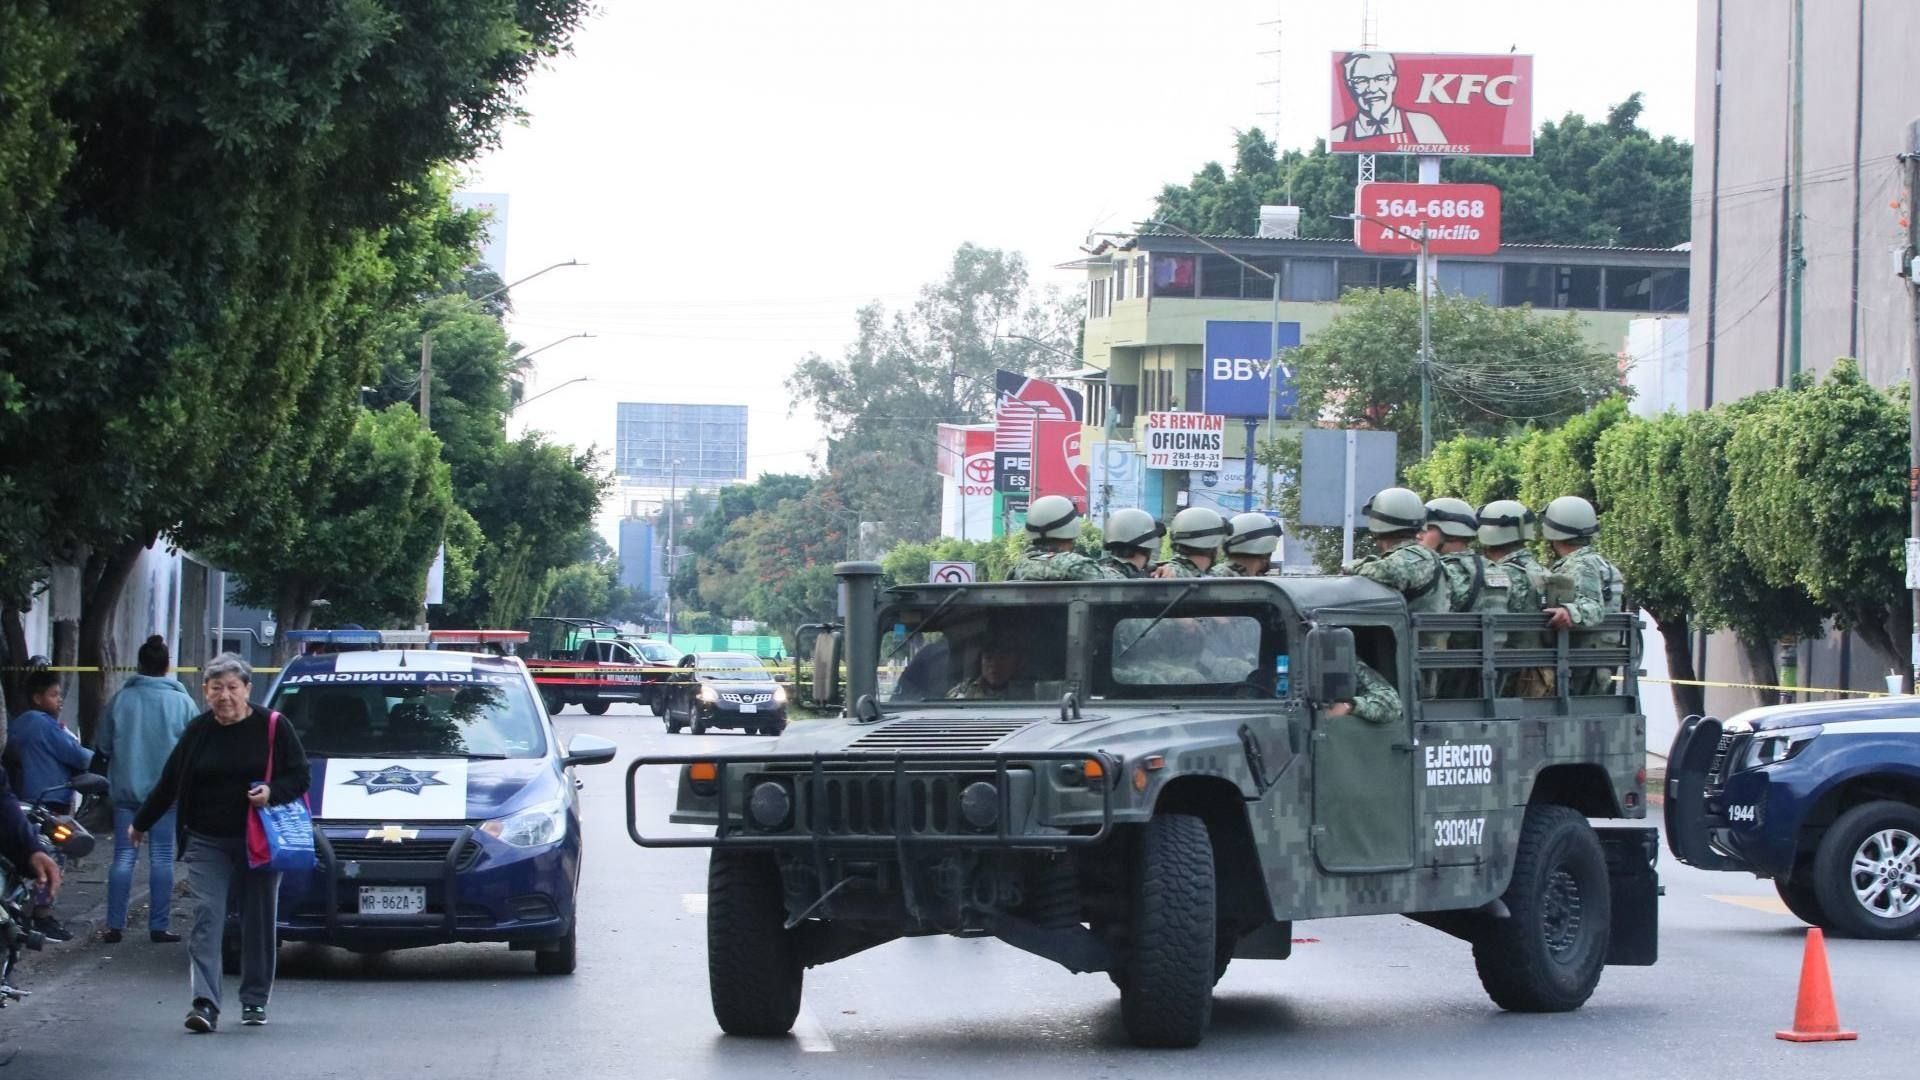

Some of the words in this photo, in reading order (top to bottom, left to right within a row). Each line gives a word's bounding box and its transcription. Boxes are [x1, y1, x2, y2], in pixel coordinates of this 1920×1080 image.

[1415, 73, 1519, 106] KFC
[1396, 144, 1471, 154] AUTOEXPRESS
[1376, 199, 1485, 218] 364-6868
[1380, 226, 1394, 240] A
[1398, 225, 1480, 240] Domicilio
[1150, 413, 1167, 428] SE
[1170, 414, 1222, 430] RENTAN
[1152, 432, 1220, 450] OFICINAS
[1152, 453, 1169, 465] 777
[1425, 740, 1493, 768] EJÉRCITO
[1426, 768, 1492, 786] MEXICANO
[1728, 805, 1755, 821] 1944
[1434, 818, 1486, 847] 3303147
[361, 895, 424, 910] MR-862A-3
